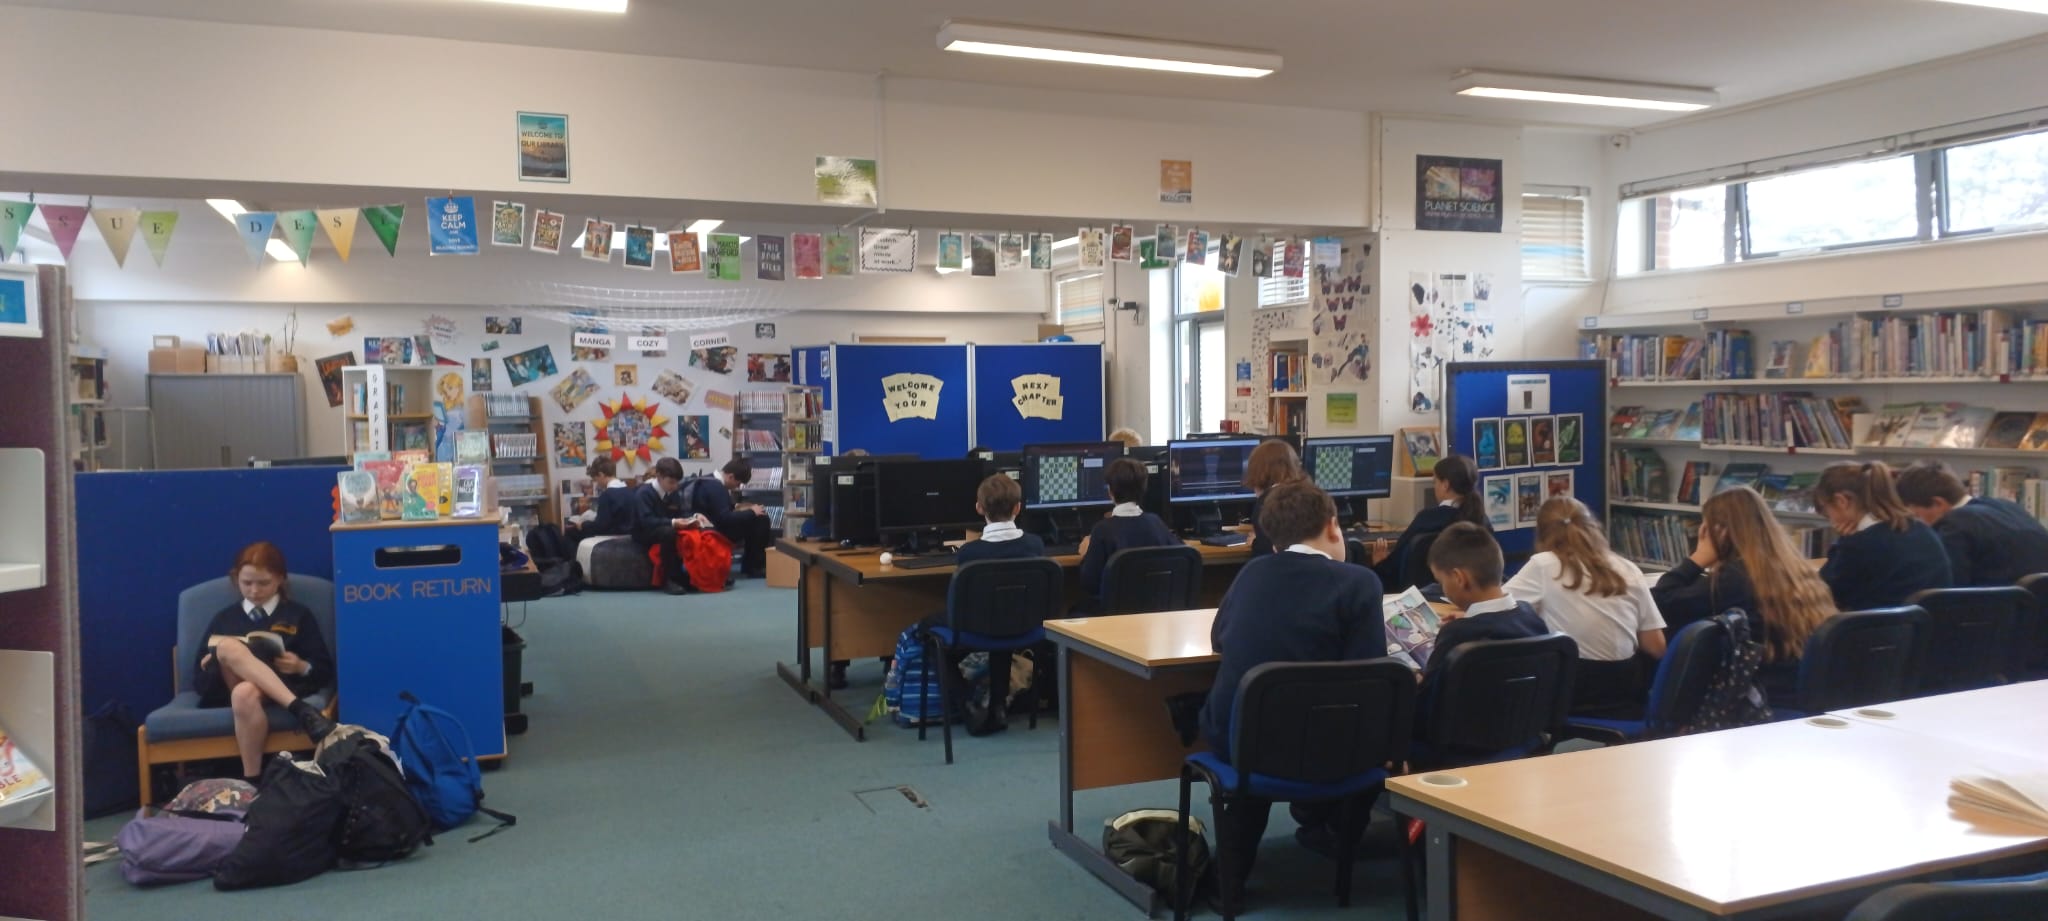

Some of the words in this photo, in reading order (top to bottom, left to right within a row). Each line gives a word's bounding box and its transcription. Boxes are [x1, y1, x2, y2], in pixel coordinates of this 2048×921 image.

[1424, 200, 1457, 211] PLANET
[1460, 202, 1495, 213] SCIENCE
[442, 214, 462, 222] KEEP
[440, 221, 466, 230] CALM
[763, 243, 779, 252] THIS
[579, 336, 611, 346] MANGA
[636, 339, 659, 347] COZY
[693, 337, 727, 347] CORNER
[888, 381, 936, 392] WELCOME
[1022, 382, 1048, 390] NEXT
[907, 390, 918, 399] TO
[1017, 393, 1057, 406] CHAPTER
[895, 400, 927, 409] YOUR
[344, 583, 402, 602] BOOK
[412, 577, 491, 598] RETURN
